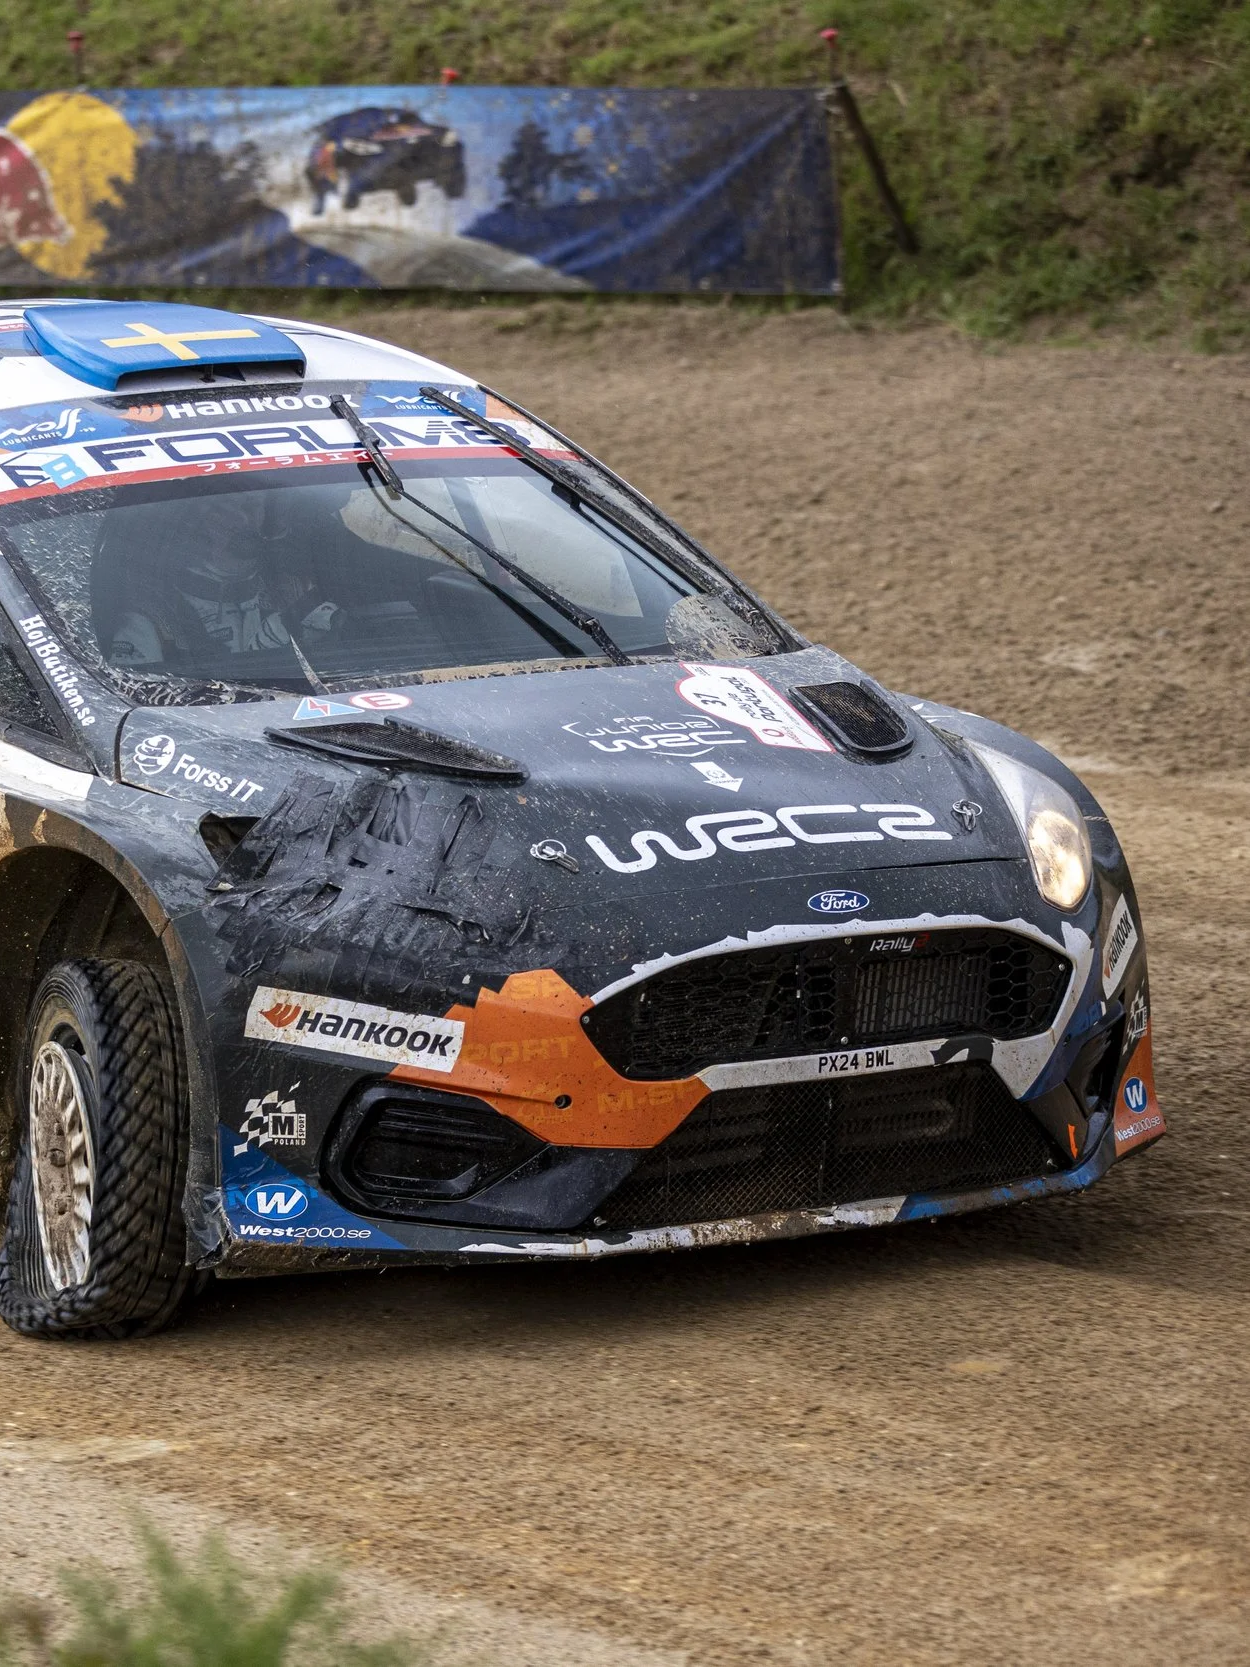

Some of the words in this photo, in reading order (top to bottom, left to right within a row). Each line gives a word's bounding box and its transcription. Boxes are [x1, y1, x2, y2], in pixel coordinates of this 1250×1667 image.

[2, 431, 63, 446] LUBRICANTS
[83, 420, 531, 472] FORUM8
[361, 694, 401, 708] E
[692, 692, 727, 707] 37
[720, 676, 783, 723] Portugal
[585, 721, 713, 736] JUNIOR
[613, 716, 654, 724] FIA
[588, 731, 747, 752] WRC
[173, 754, 232, 792] Forss
[230, 778, 264, 802] IT
[585, 804, 953, 874] WRC2
[820, 893, 860, 910] Ford
[870, 933, 930, 952] Rally2
[818, 1053, 859, 1074] PX24
[865, 1050, 894, 1068] BWL
[1125, 1080, 1143, 1108] W
[271, 1115, 295, 1136] M
[1115, 1114, 1161, 1142] West2000.se
[274, 1138, 306, 1146] POLAND
[256, 1189, 303, 1214] W
[240, 1224, 372, 1239] West2000.se
